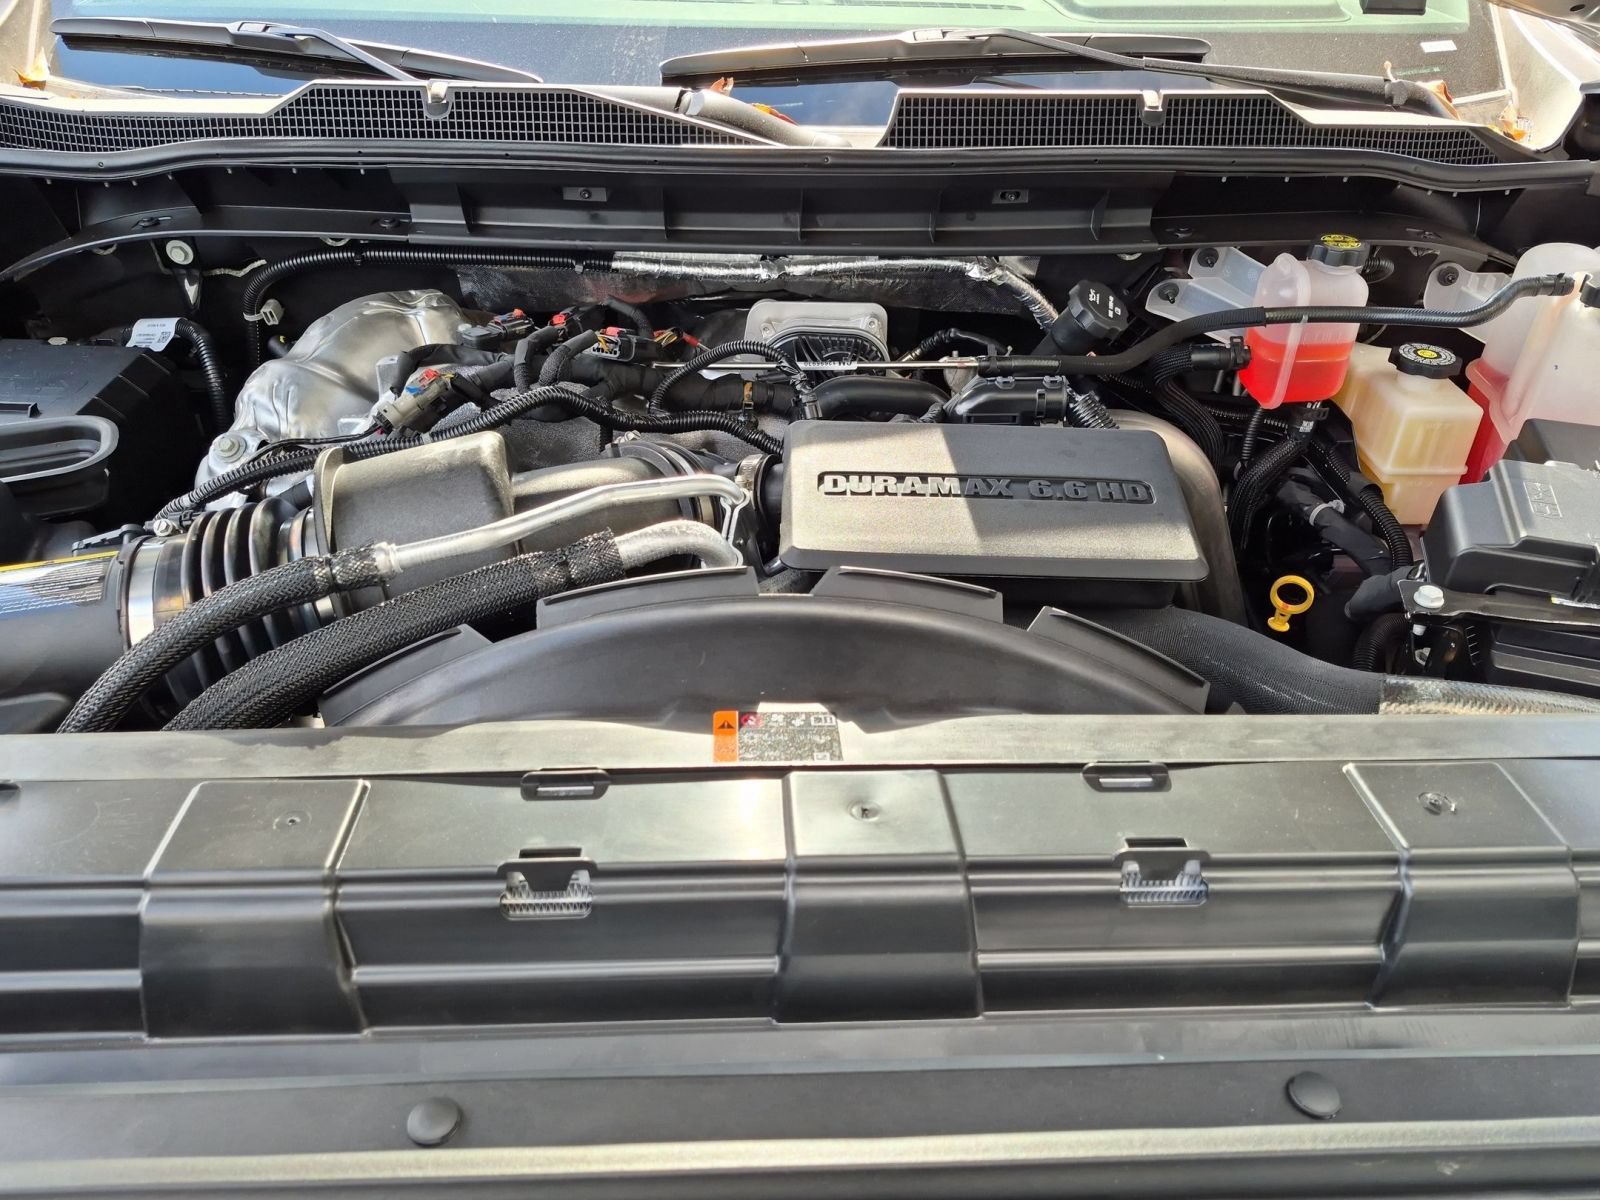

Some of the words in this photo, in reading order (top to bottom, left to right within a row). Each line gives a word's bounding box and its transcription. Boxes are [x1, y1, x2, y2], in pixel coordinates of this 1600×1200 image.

[823, 474, 1013, 497] DURAMAX
[1028, 479, 1088, 499] 6.6
[1096, 482, 1149, 502] HD
